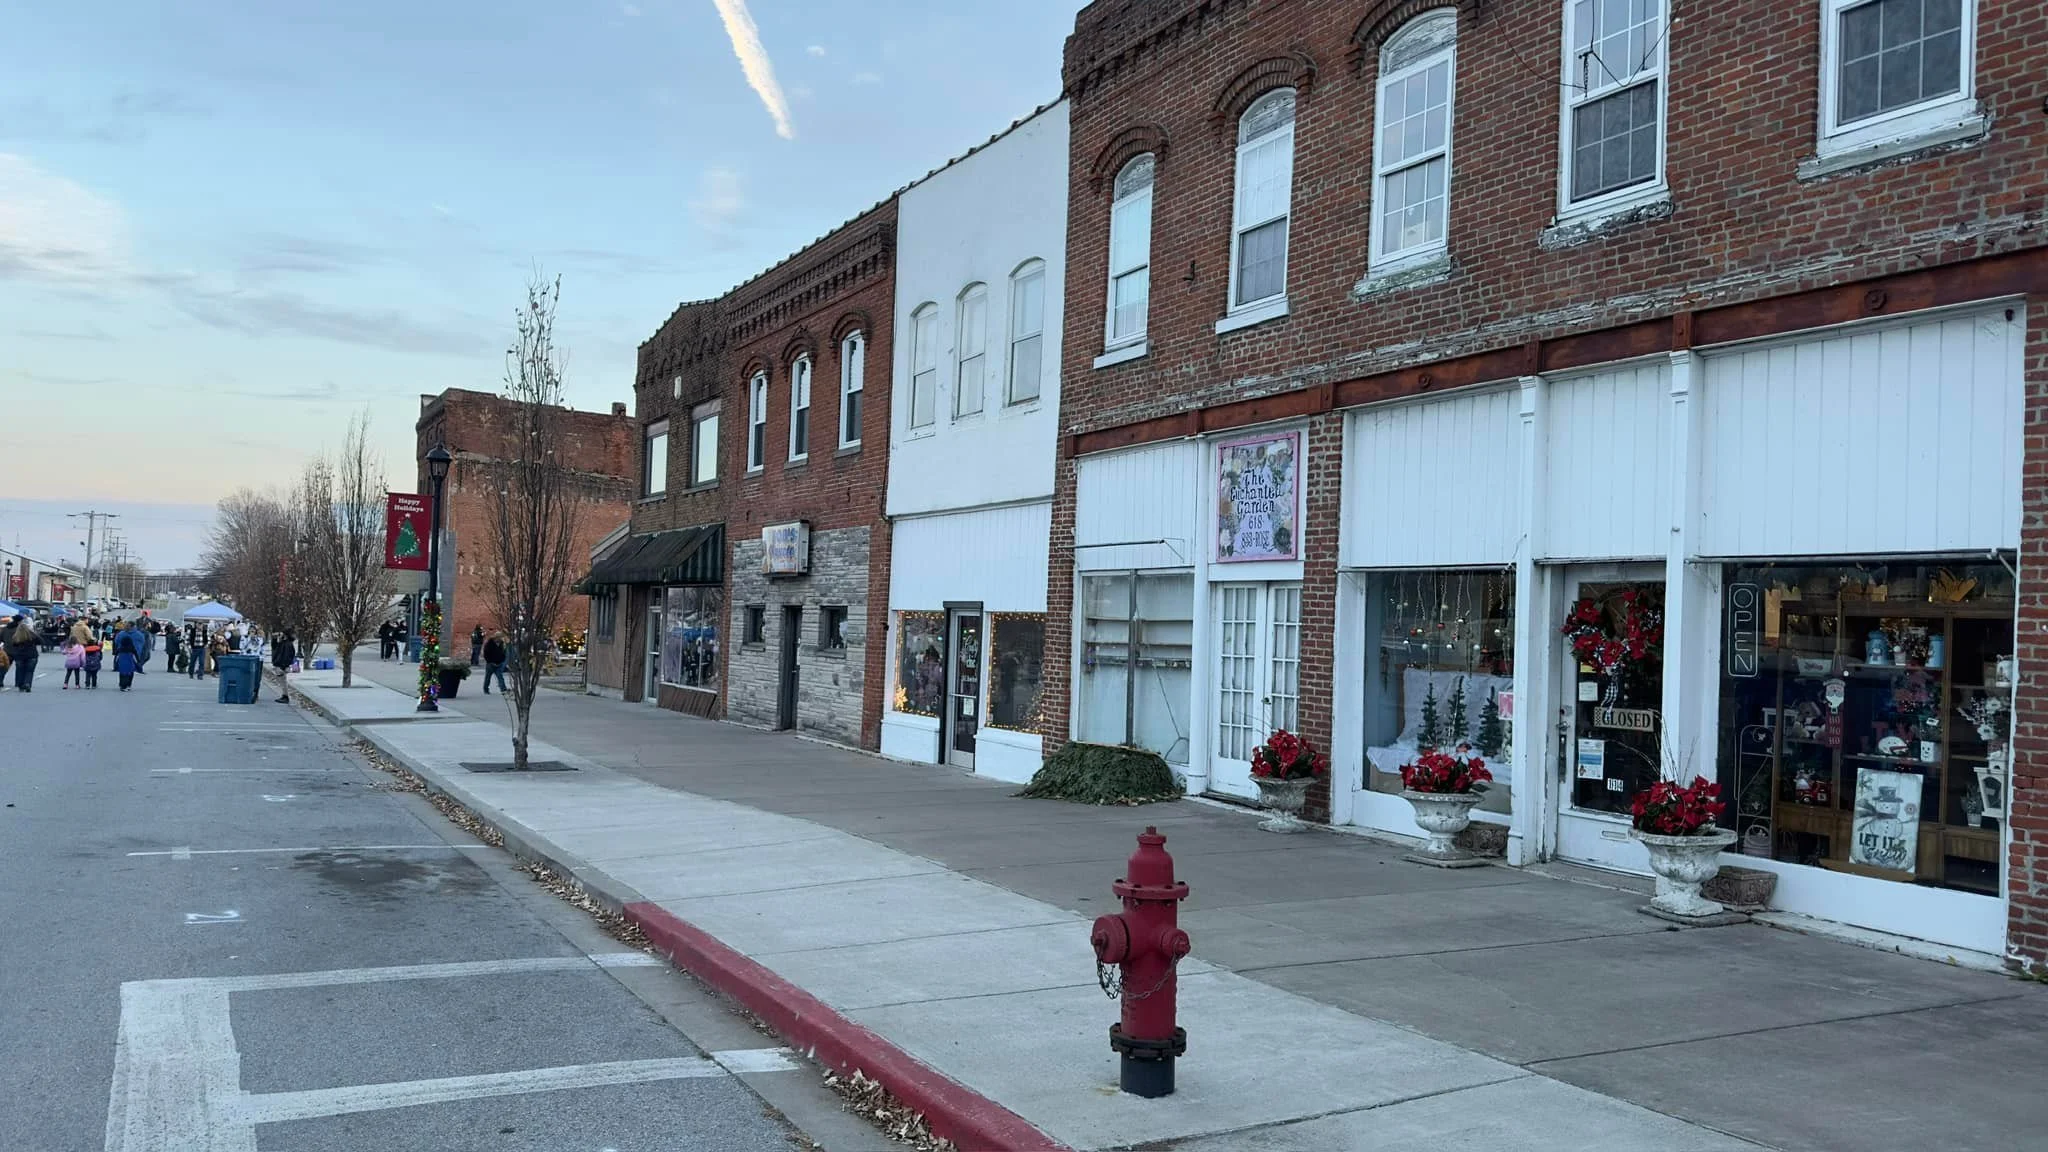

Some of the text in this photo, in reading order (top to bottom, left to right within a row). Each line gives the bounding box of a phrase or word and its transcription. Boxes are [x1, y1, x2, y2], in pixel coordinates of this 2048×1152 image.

[1244, 469, 1265, 486] The
[1231, 485, 1283, 502] Enchanted
[394, 504, 424, 512] Holidays
[1237, 498, 1275, 515] Garden
[1732, 588, 1754, 672] OPEN
[1602, 707, 1651, 728] CLOSED
[1859, 833, 1895, 848] LET IT
